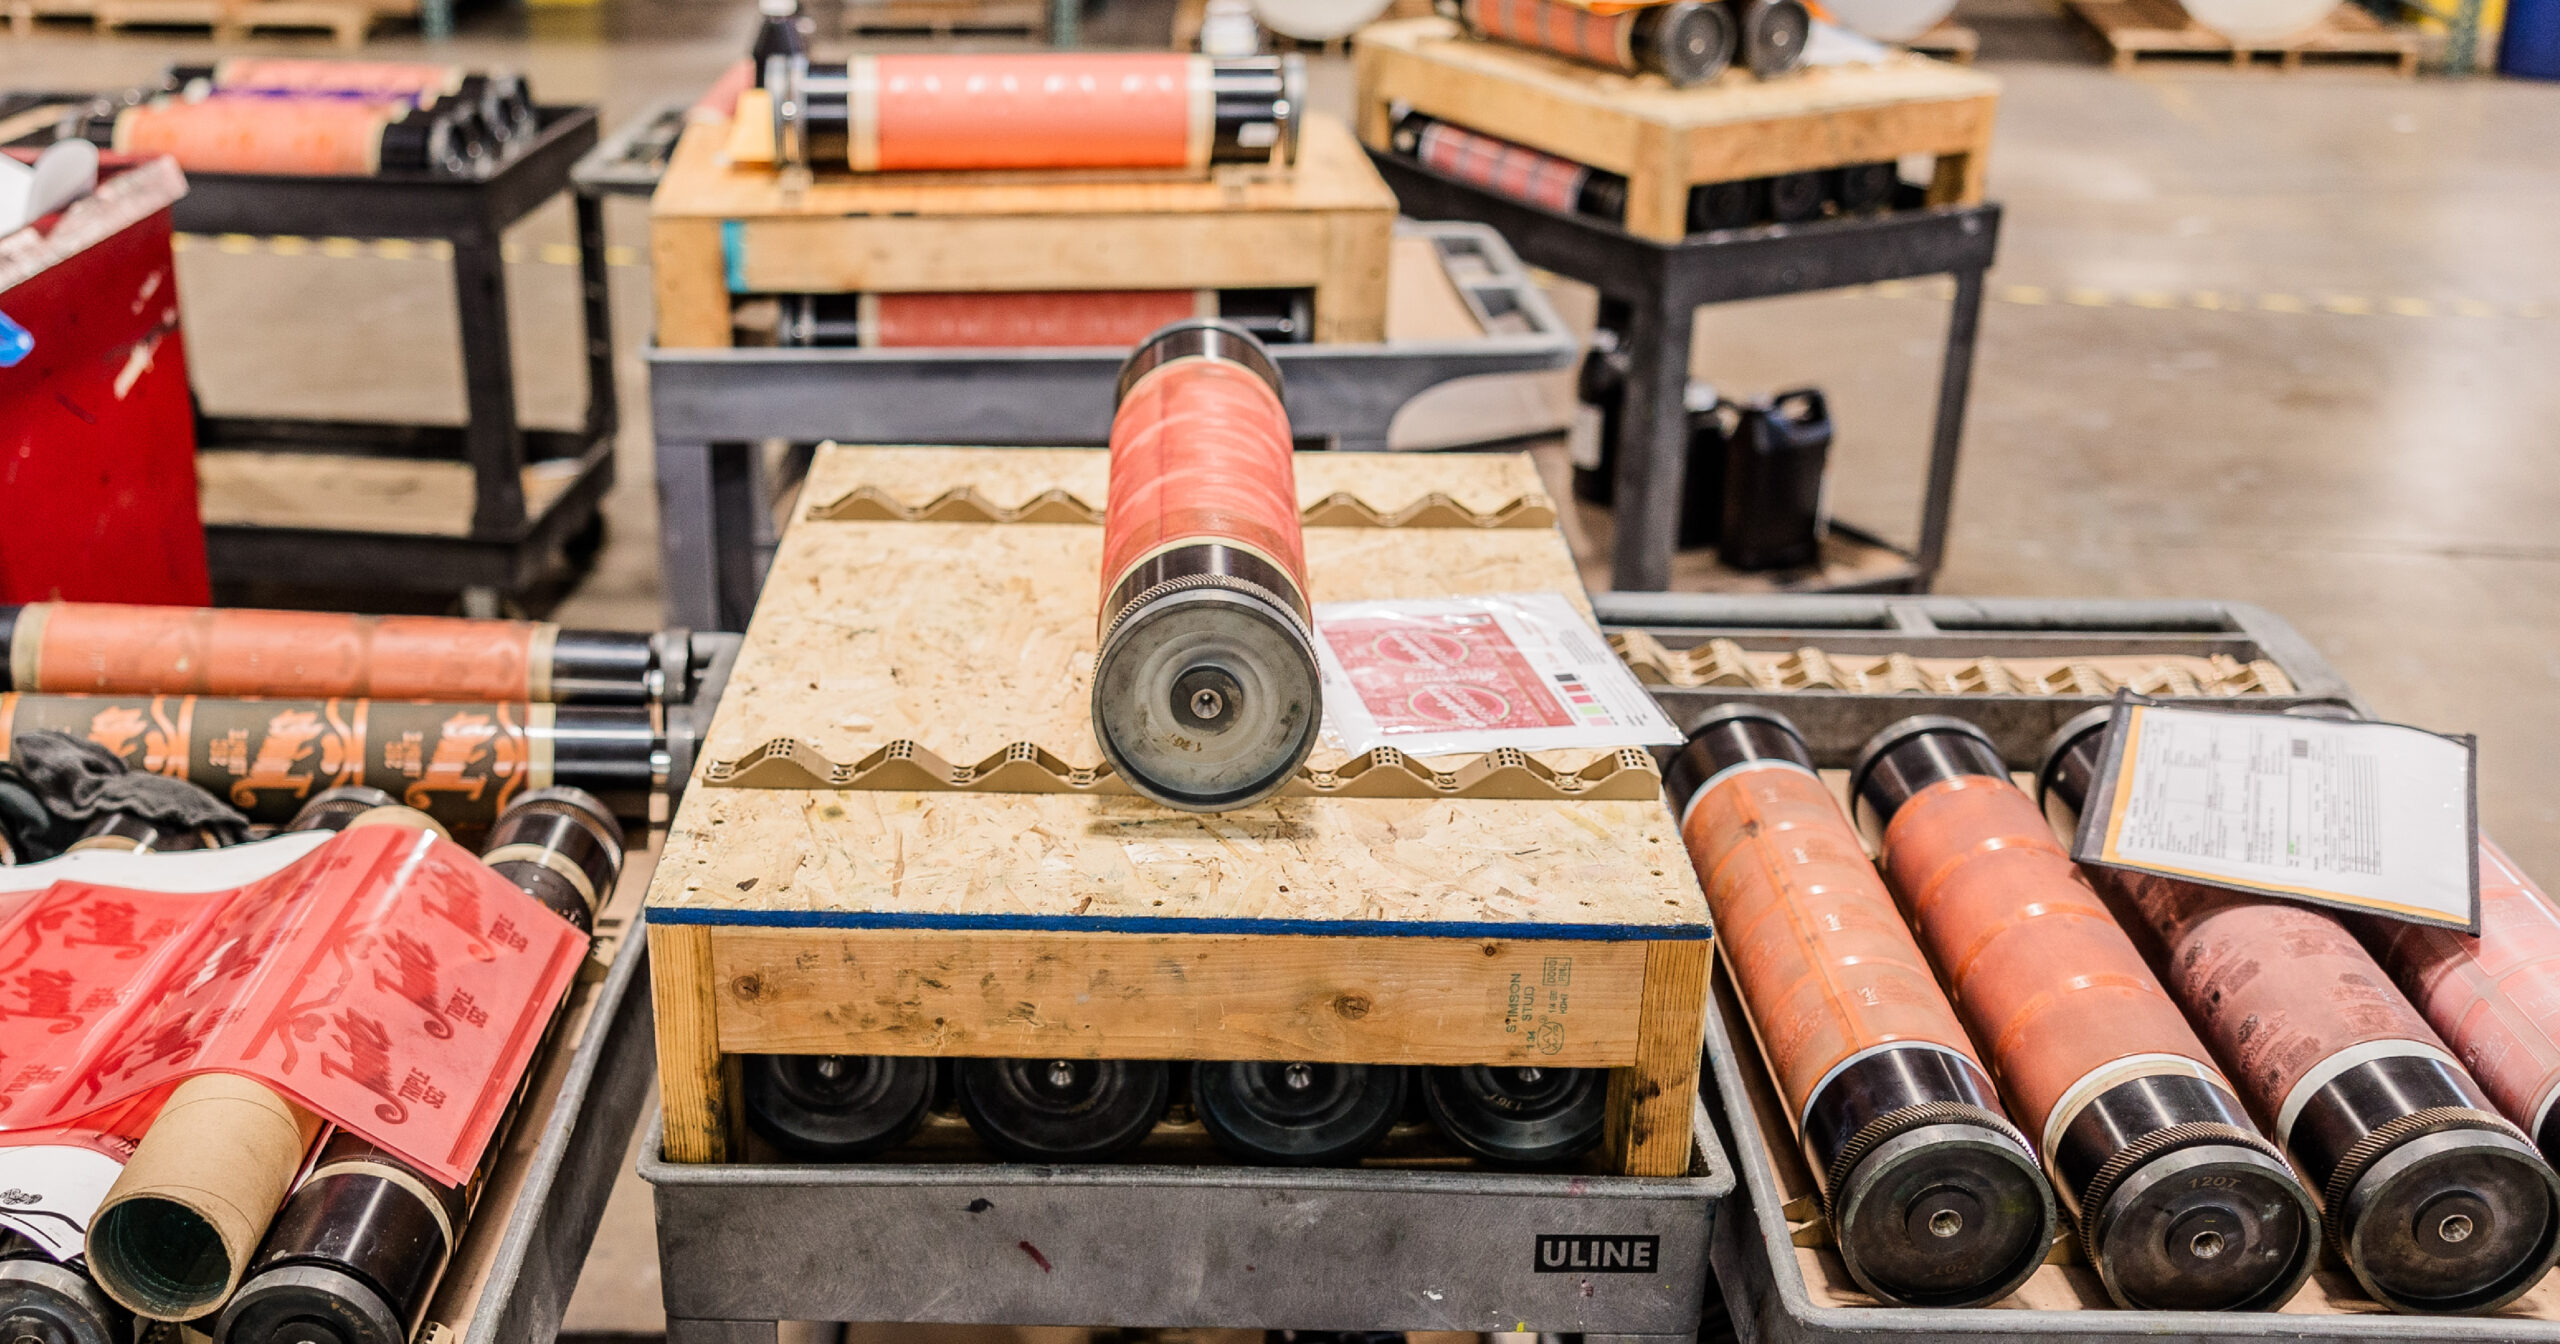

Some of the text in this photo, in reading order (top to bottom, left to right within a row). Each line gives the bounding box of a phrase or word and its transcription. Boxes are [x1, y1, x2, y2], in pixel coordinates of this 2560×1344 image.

[445, 987, 474, 1022] TRIPLE
[466, 1006, 489, 1028] SEC
[1522, 986, 1535, 1022] STUD
[398, 1067, 430, 1104] TRIPLE
[422, 1085, 447, 1109] SEC
[1543, 1240, 1651, 1267] ULINE
